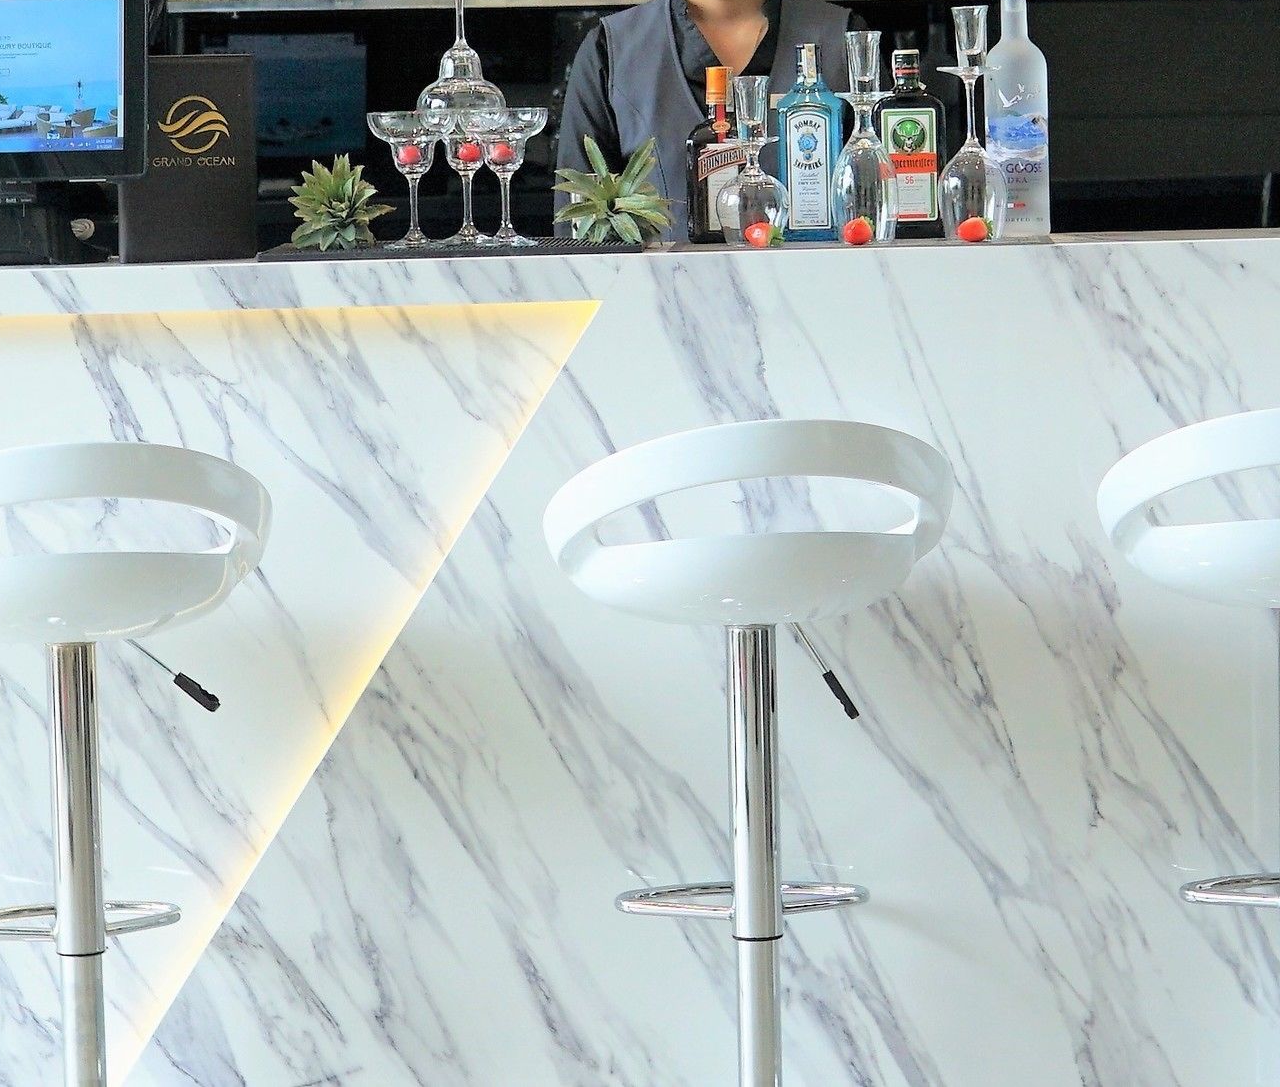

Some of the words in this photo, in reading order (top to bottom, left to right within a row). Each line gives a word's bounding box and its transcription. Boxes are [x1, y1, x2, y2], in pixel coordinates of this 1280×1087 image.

[793, 119, 822, 133] BOMBAY
[152, 156, 192, 168] GRAND
[197, 156, 236, 167] OCEAN
[792, 158, 824, 171] SAPPHIRE
[1005, 162, 1043, 174] GOOSE
[1006, 176, 1028, 184] DKA
